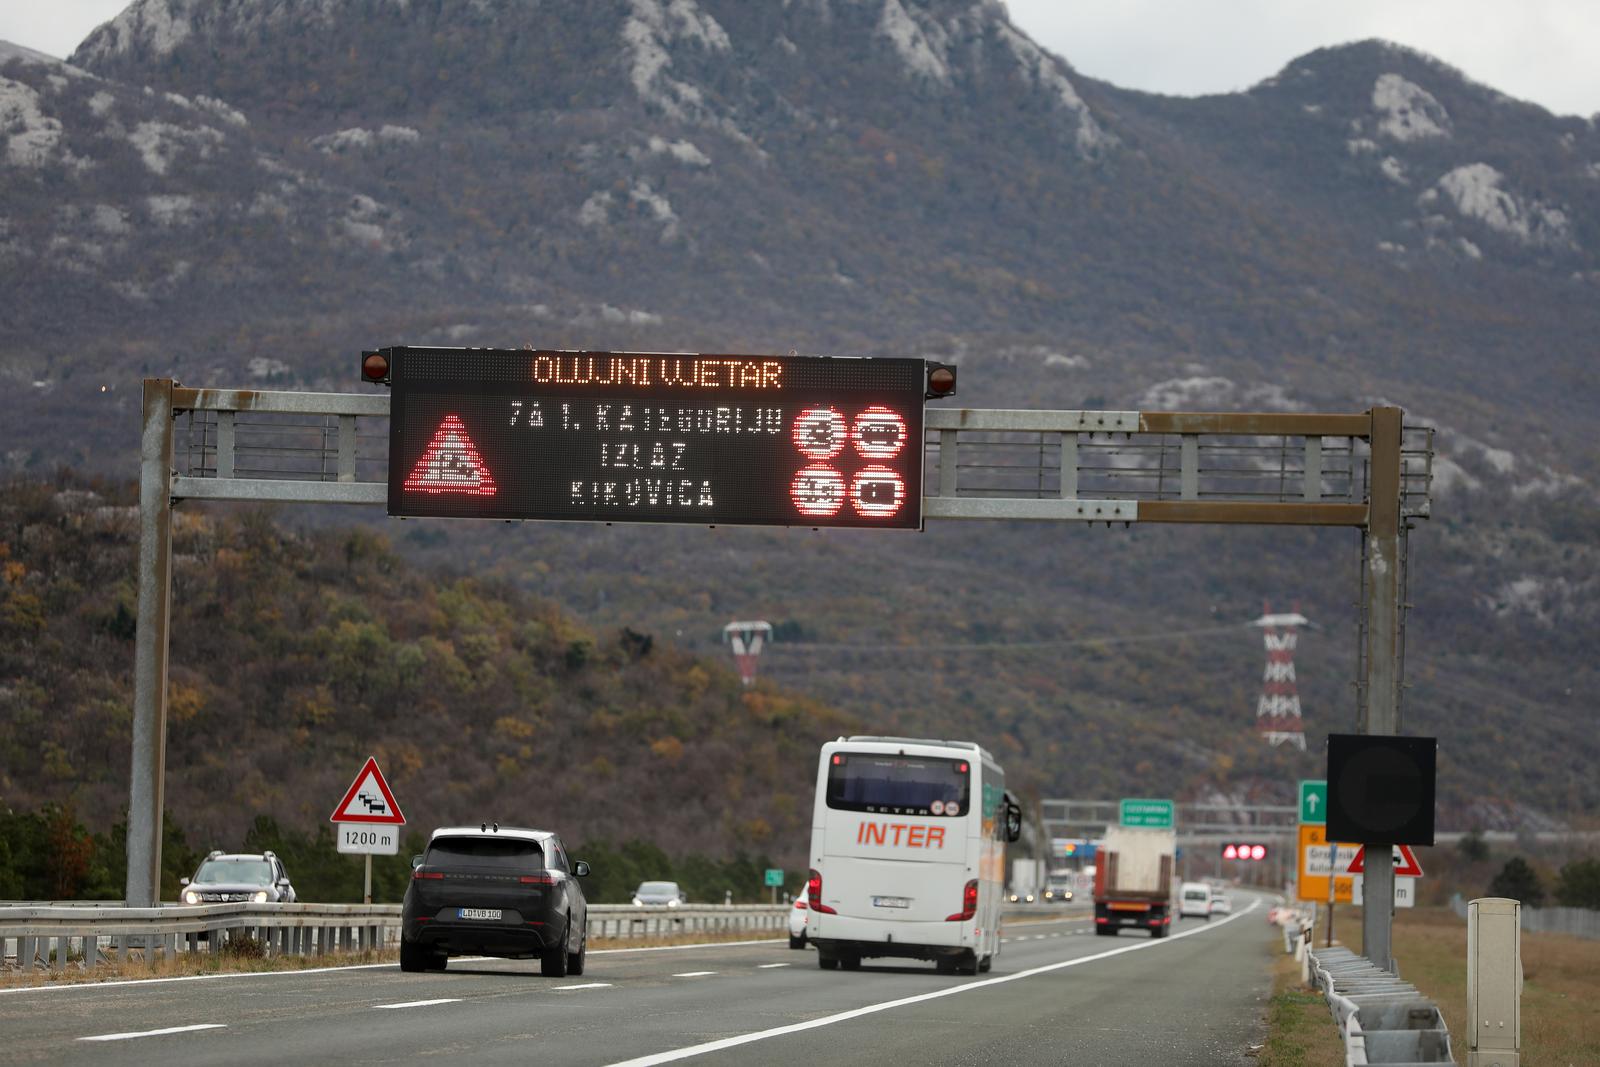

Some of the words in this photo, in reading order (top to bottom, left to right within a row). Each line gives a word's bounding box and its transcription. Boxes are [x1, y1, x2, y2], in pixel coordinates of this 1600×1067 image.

[534, 356, 651, 385] OLUJNI
[660, 359, 782, 388] VJETAR
[602, 442, 686, 471] IZLAZ
[346, 831, 377, 845] 1200
[381, 835, 391, 846] m
[857, 821, 946, 849] INTER
[1397, 889, 1407, 899] m
